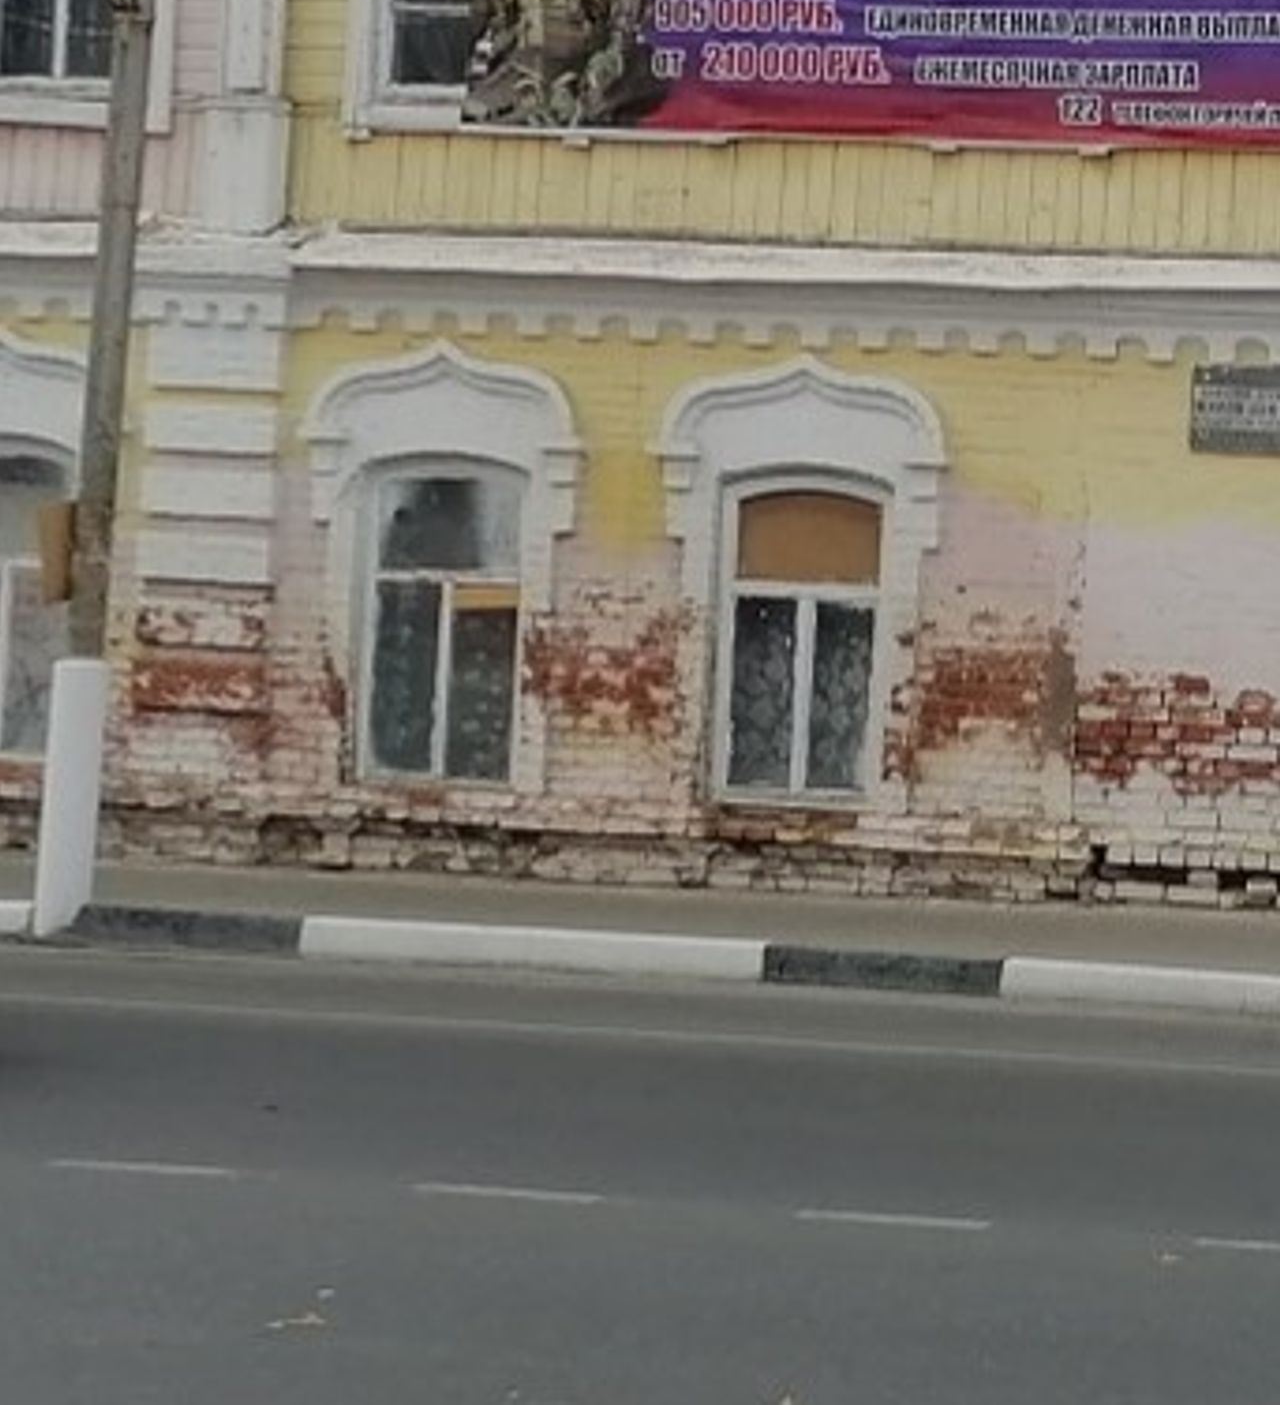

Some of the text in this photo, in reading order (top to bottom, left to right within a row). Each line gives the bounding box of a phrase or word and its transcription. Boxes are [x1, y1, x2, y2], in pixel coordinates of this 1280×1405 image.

[865, 4, 1070, 39] ЕДИНОВРЕМЕННАЯ
[1072, 10, 1192, 42] ДЕНЕЖНАЯ
[701, 42, 758, 82] 210
[759, 43, 821, 82] 000
[823, 45, 892, 85] РУБ.
[914, 56, 1199, 90] ЕЖЕМЕСЯЧНАЯ ЗАРПЛАТА
